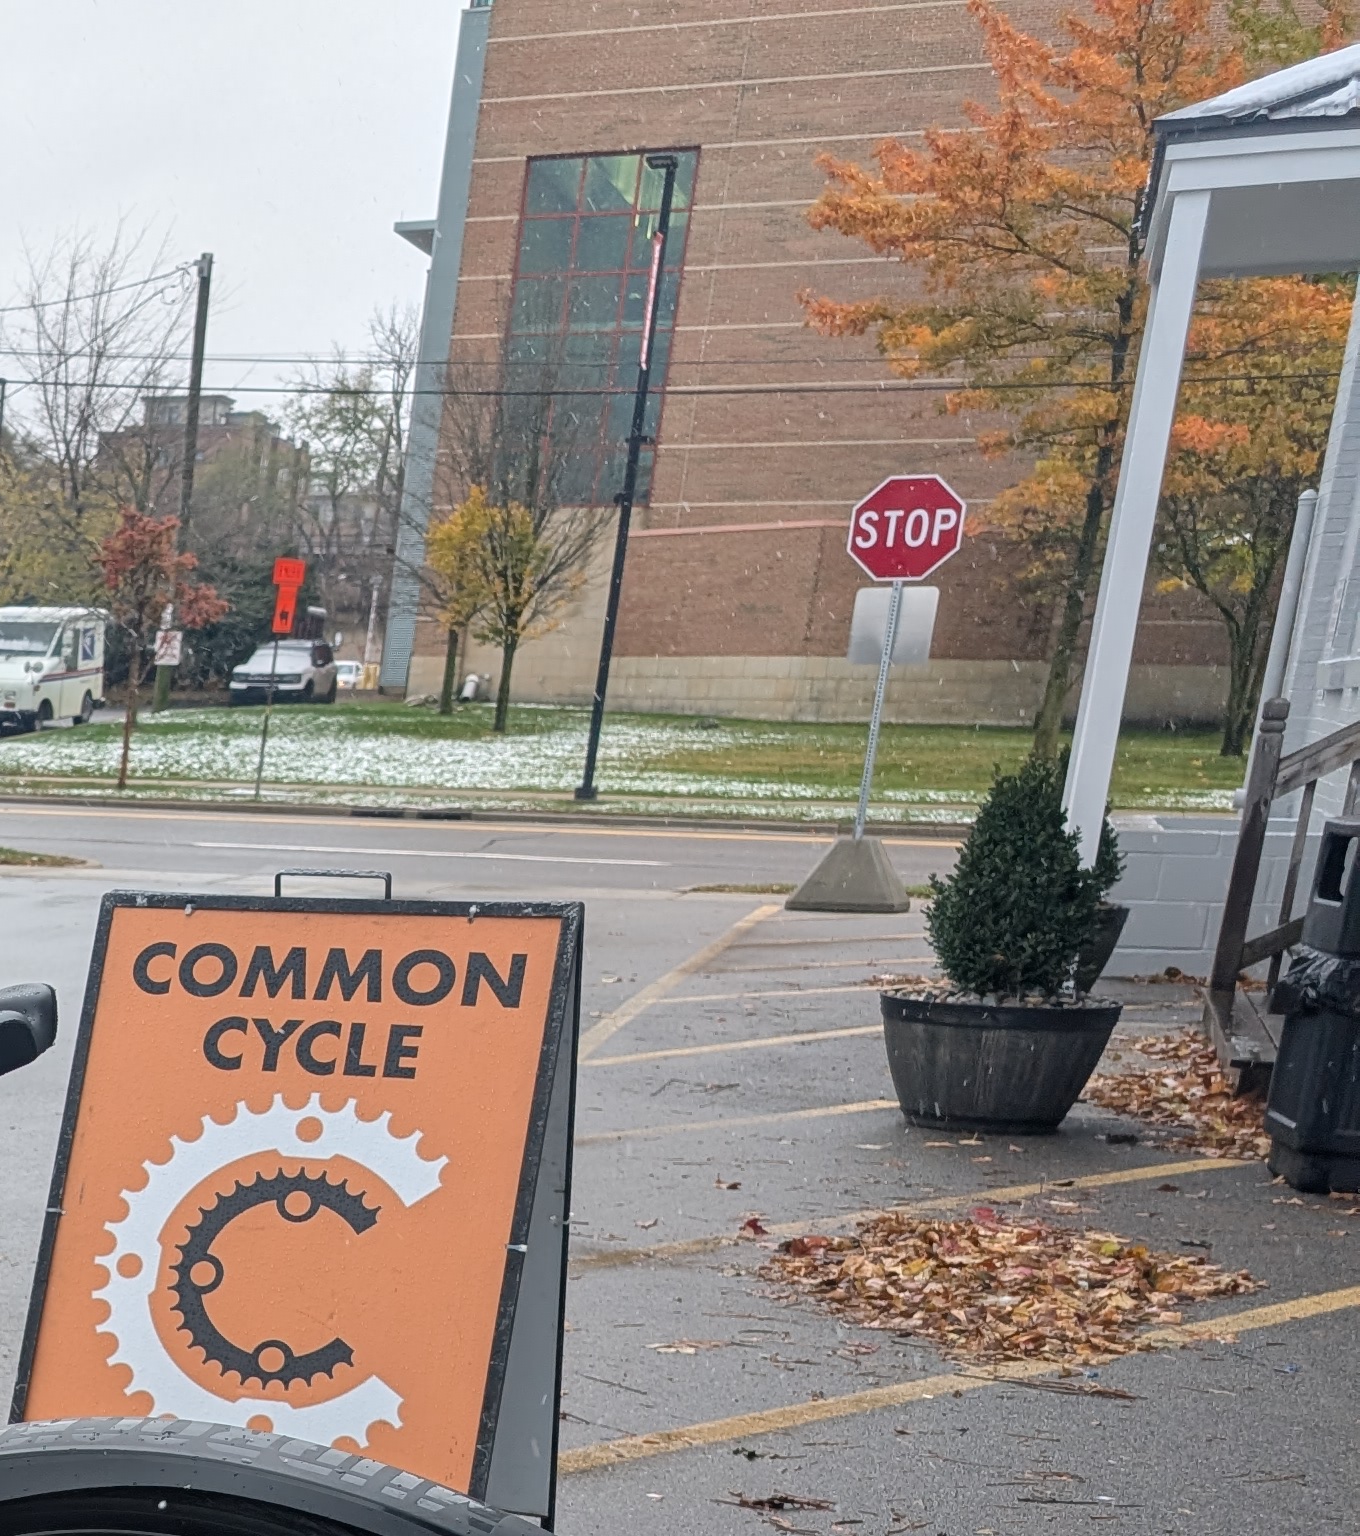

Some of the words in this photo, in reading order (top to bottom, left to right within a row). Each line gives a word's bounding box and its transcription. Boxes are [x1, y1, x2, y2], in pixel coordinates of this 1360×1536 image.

[855, 508, 958, 549] STOP
[132, 941, 528, 1009] COMMON
[202, 1016, 424, 1079] CYCLE
